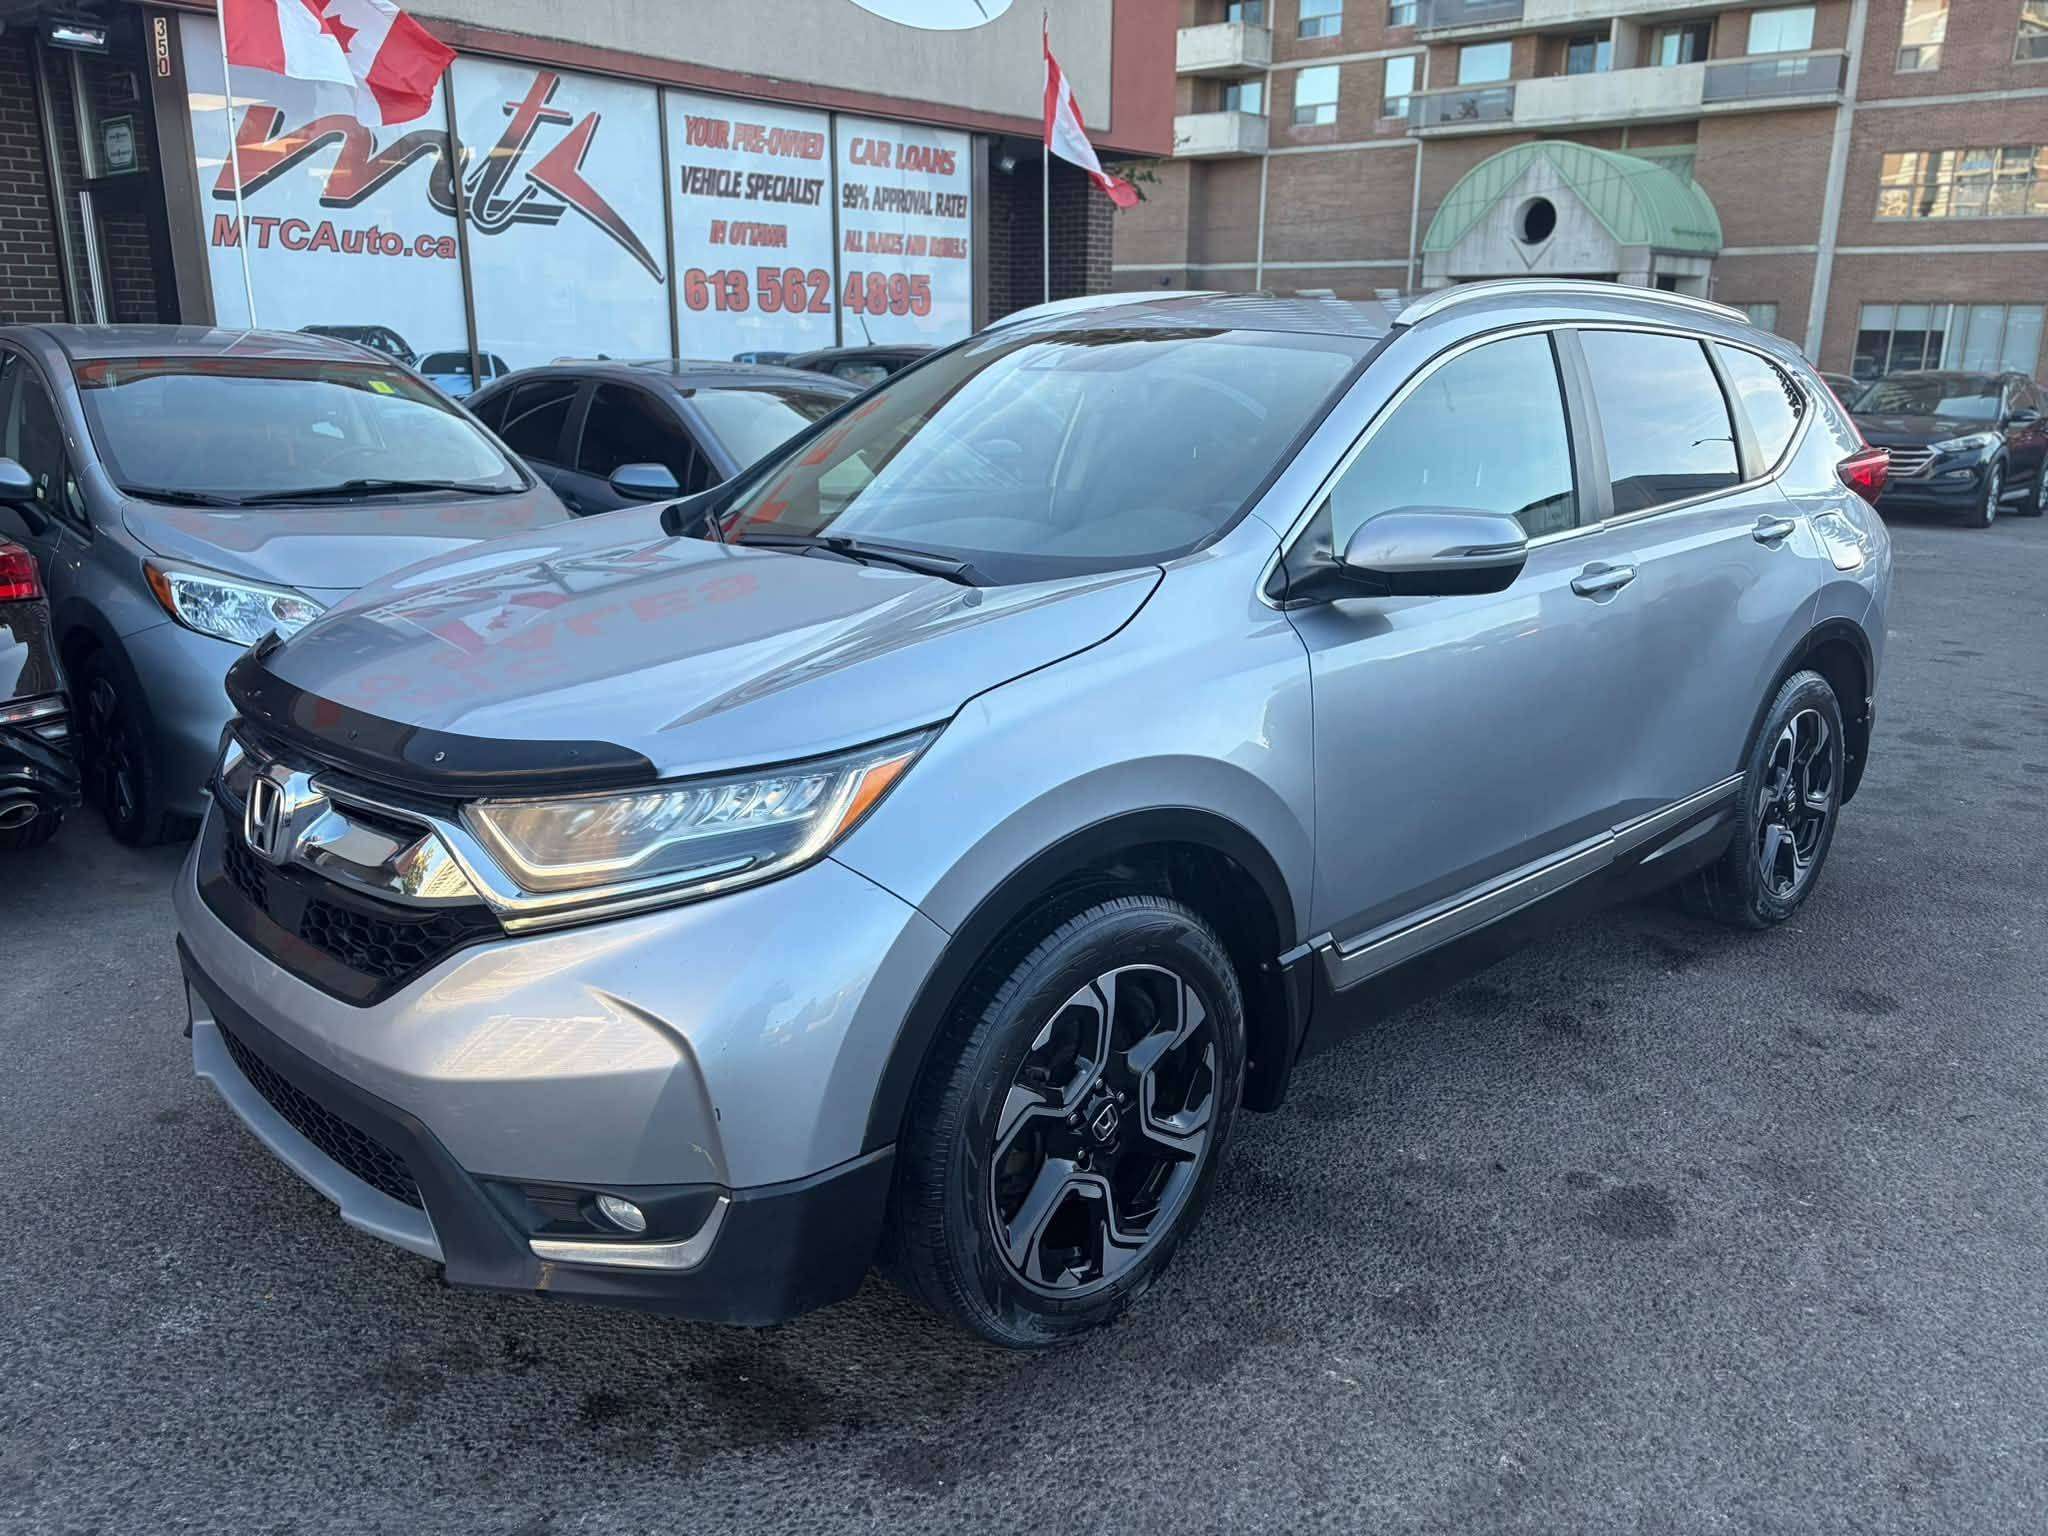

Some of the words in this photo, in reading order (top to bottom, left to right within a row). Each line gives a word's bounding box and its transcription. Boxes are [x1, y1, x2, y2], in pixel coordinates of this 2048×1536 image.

[156, 18, 169, 75] 350
[684, 114, 730, 151] YOUR
[731, 121, 825, 161] PRE-OWNED
[849, 137, 892, 169] CAR
[895, 143, 957, 176] LOANS
[681, 164, 743, 199] VEHICLE
[744, 171, 825, 206] SPECIALIST
[842, 182, 869, 211] 99%
[871, 185, 933, 217] APPROVAL
[935, 192, 968, 219] RATE!
[212, 213, 457, 259] MTCAuto.ca
[709, 219, 728, 245] IN
[843, 229, 864, 253] ALL
[684, 267, 751, 312] 613
[756, 266, 832, 314] 562
[843, 271, 932, 317] 4895
